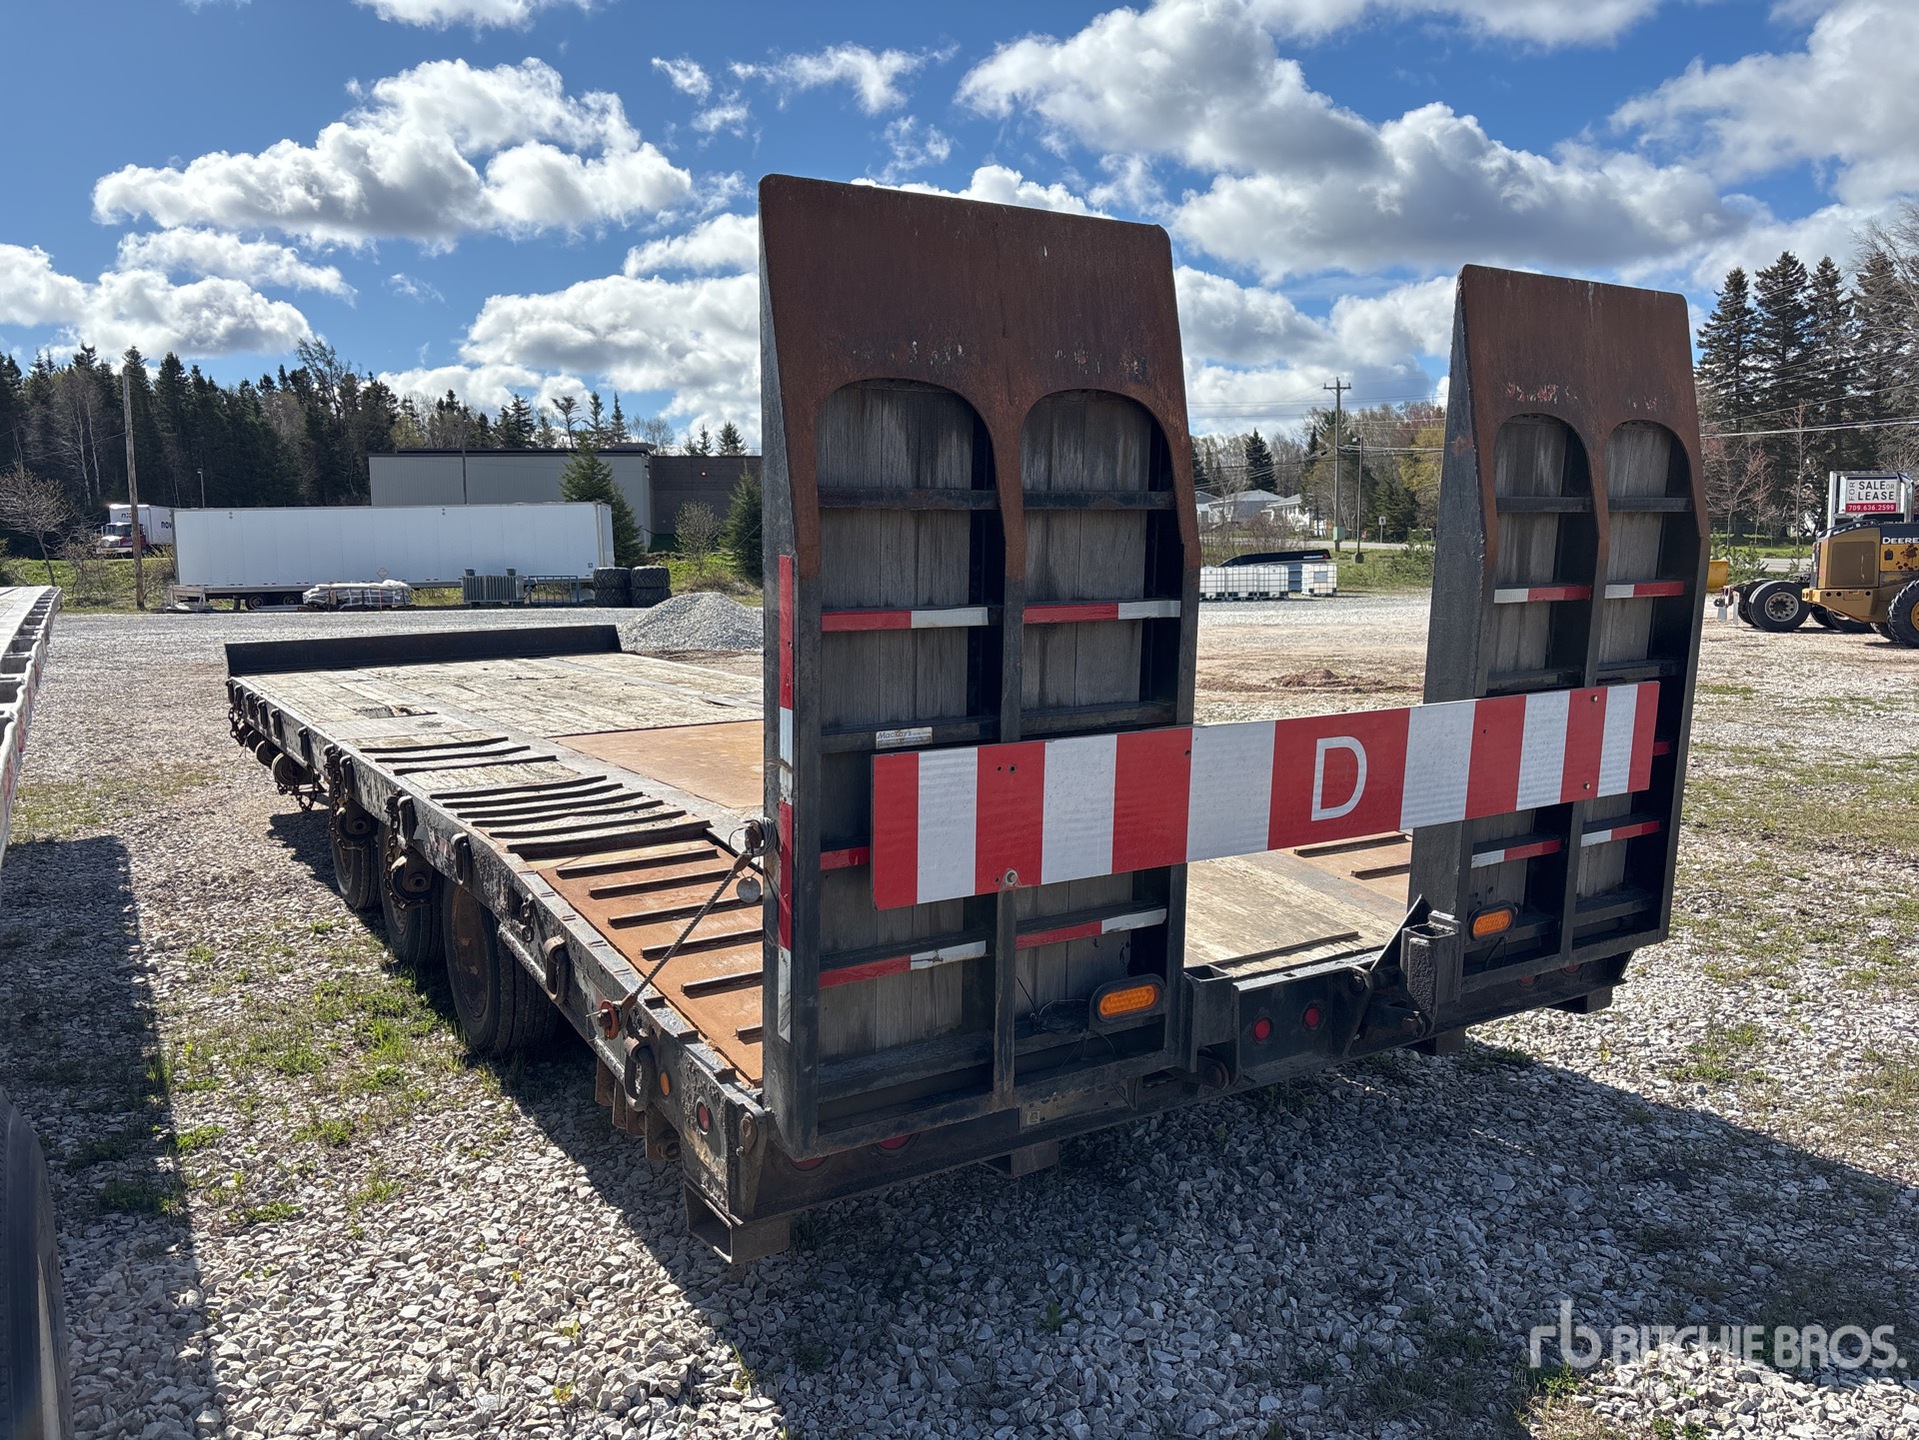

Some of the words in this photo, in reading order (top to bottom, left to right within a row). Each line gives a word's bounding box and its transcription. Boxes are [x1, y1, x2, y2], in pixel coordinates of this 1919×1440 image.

[1858, 480, 1886, 490] SALE
[1848, 481, 1856, 501] FOR
[1857, 491, 1895, 501] LEASE
[1848, 504, 1895, 512] 709.636.2599
[1882, 536, 1919, 545] DEERE
[1311, 735, 1367, 822] D
